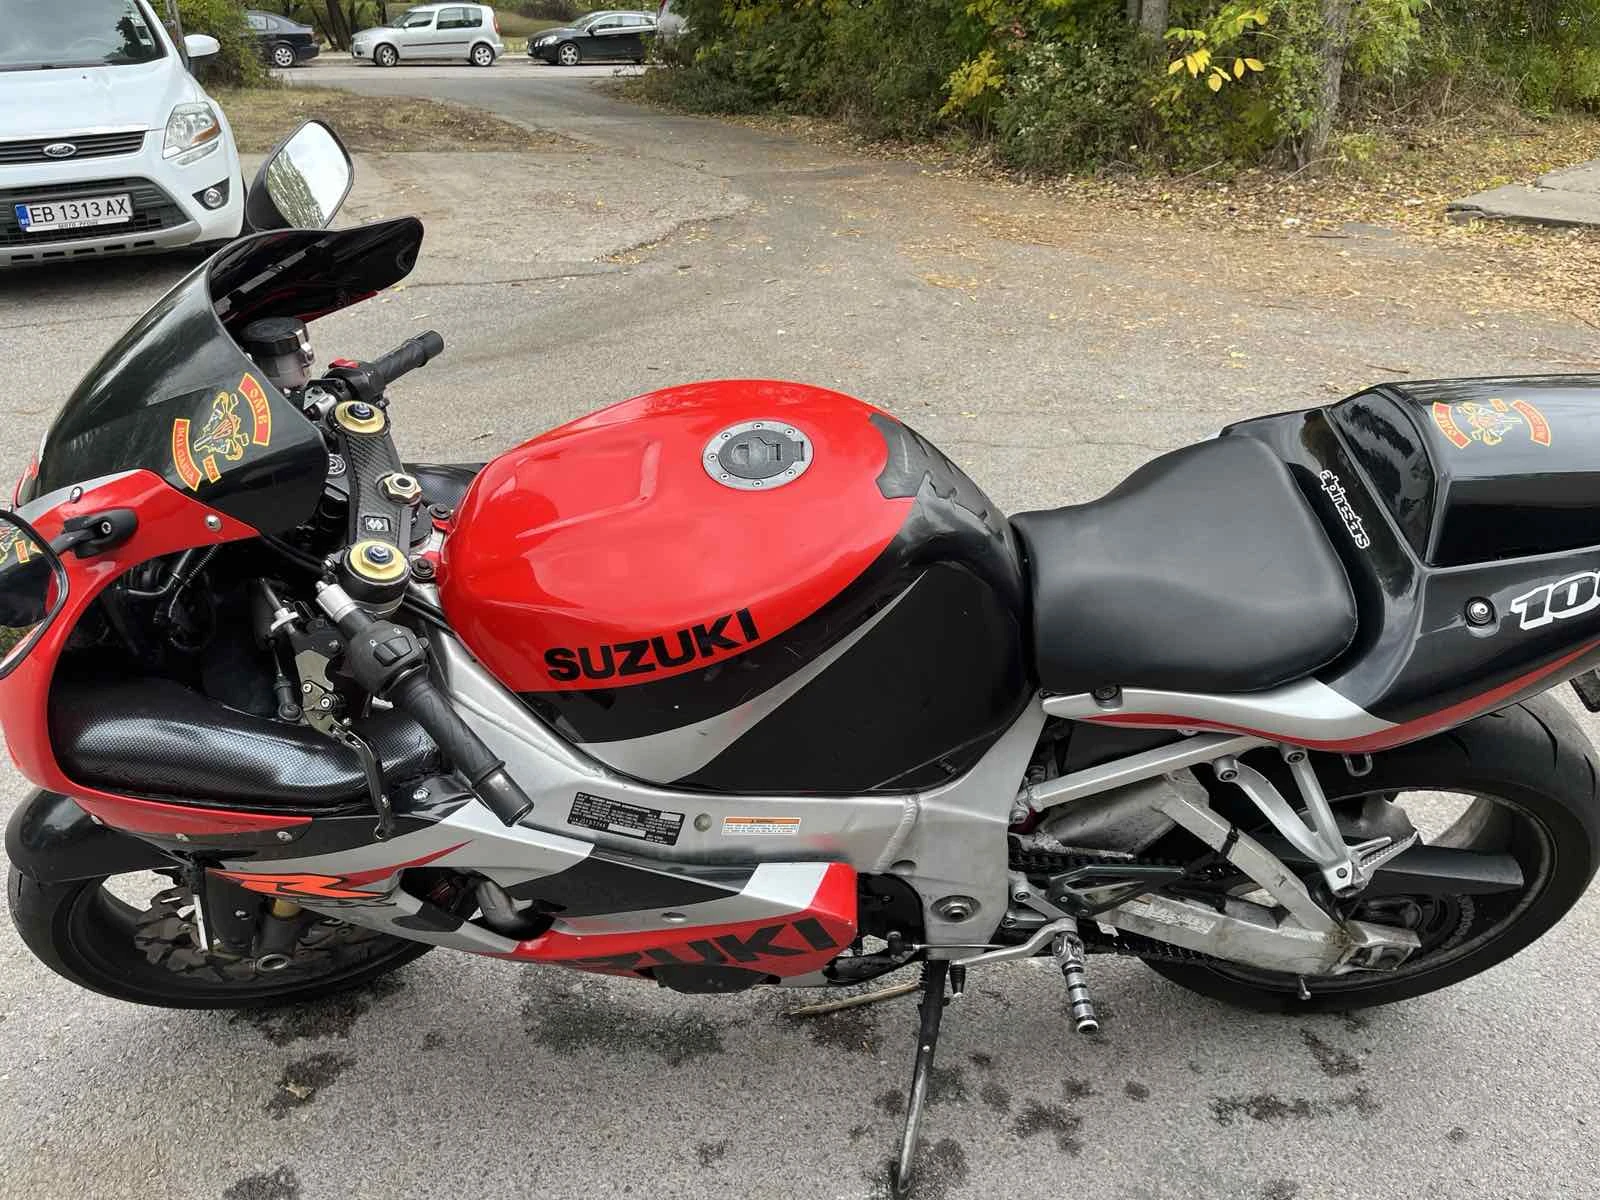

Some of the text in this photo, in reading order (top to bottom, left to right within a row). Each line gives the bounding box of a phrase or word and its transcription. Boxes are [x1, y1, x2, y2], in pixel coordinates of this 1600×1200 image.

[30, 206, 54, 224] EB
[60, 202, 101, 220] 1313
[106, 198, 128, 216] AX
[1320, 470, 1370, 549] alpinestars
[1510, 571, 1600, 630] 10
[543, 607, 760, 681] SUZUKI
